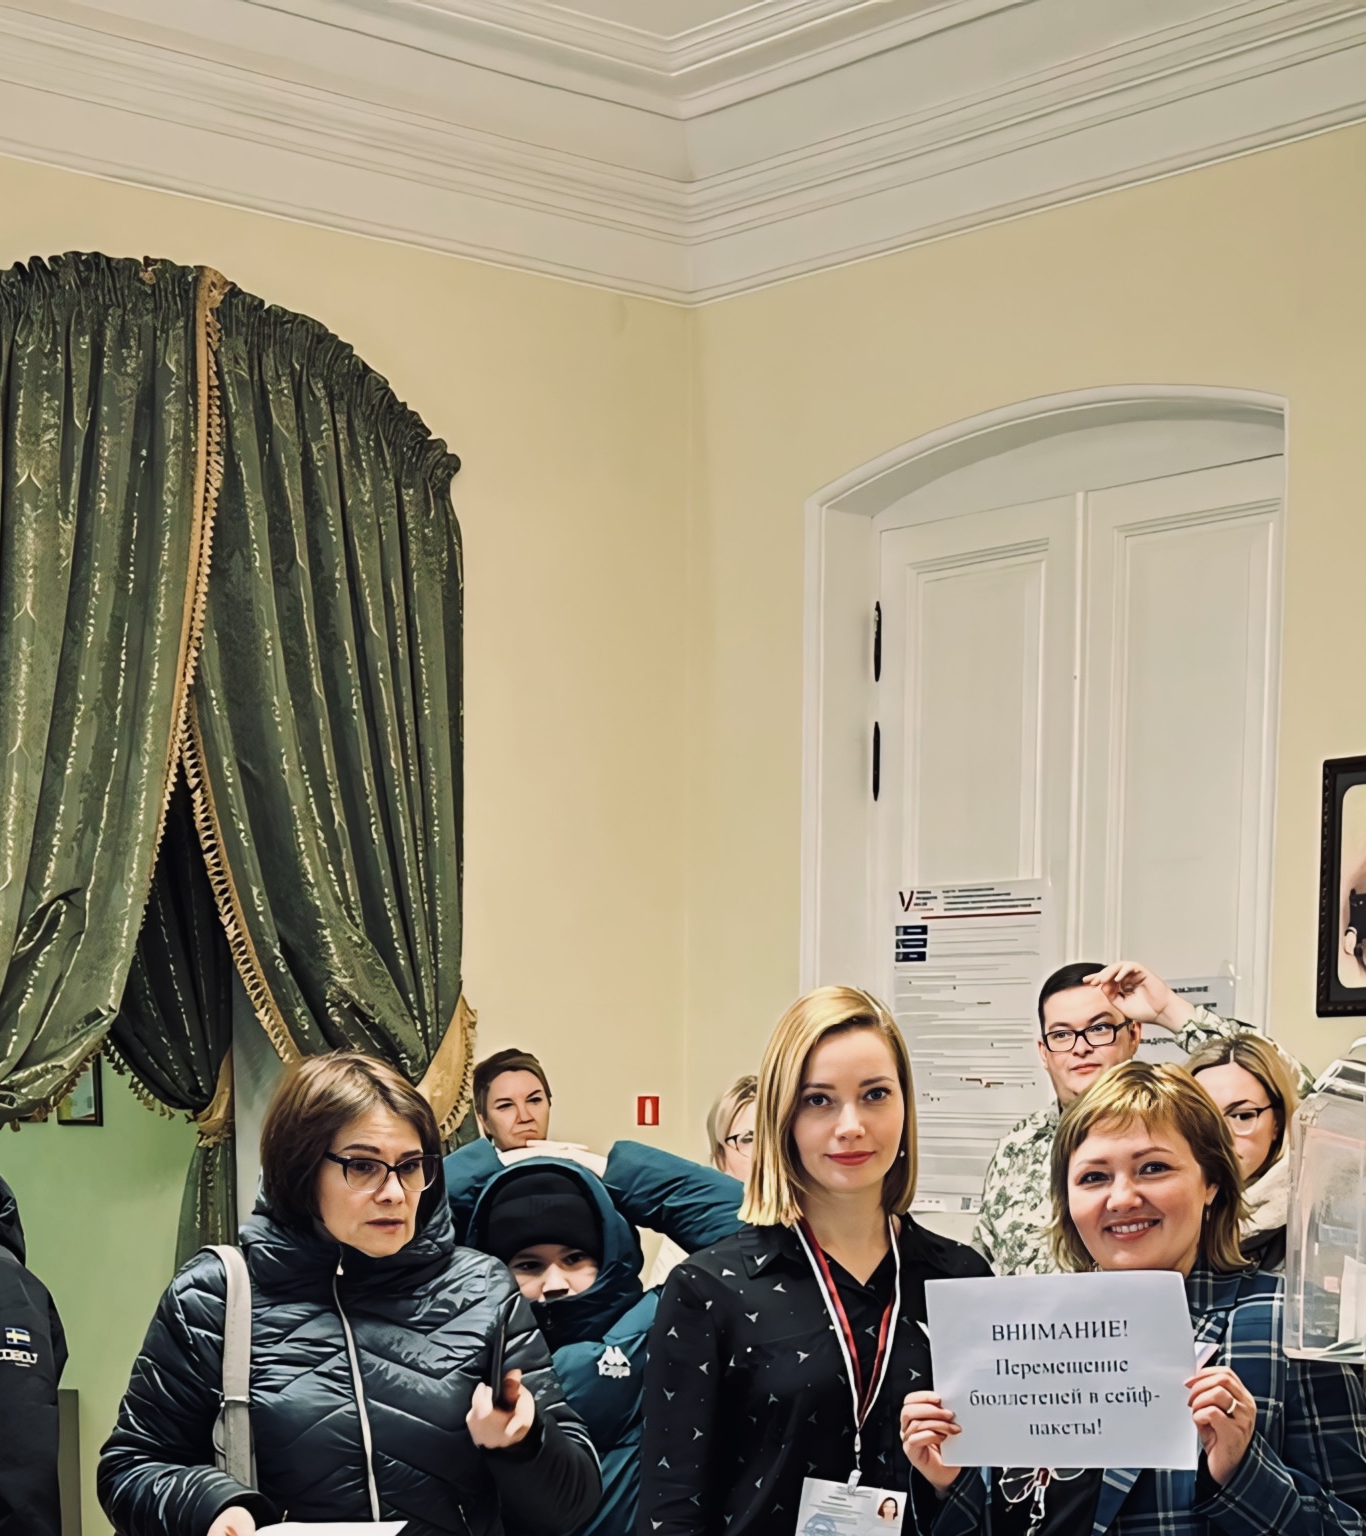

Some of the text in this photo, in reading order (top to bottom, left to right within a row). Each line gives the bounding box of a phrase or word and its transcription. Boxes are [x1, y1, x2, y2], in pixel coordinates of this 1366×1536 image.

[992, 1320, 1128, 1341] ВНИМАНИЕ!
[996, 1358, 1129, 1379] Перемещение
[969, 1386, 1160, 1407] бюллетеней в сейф-
[1029, 1418, 1102, 1435] пакеты!
